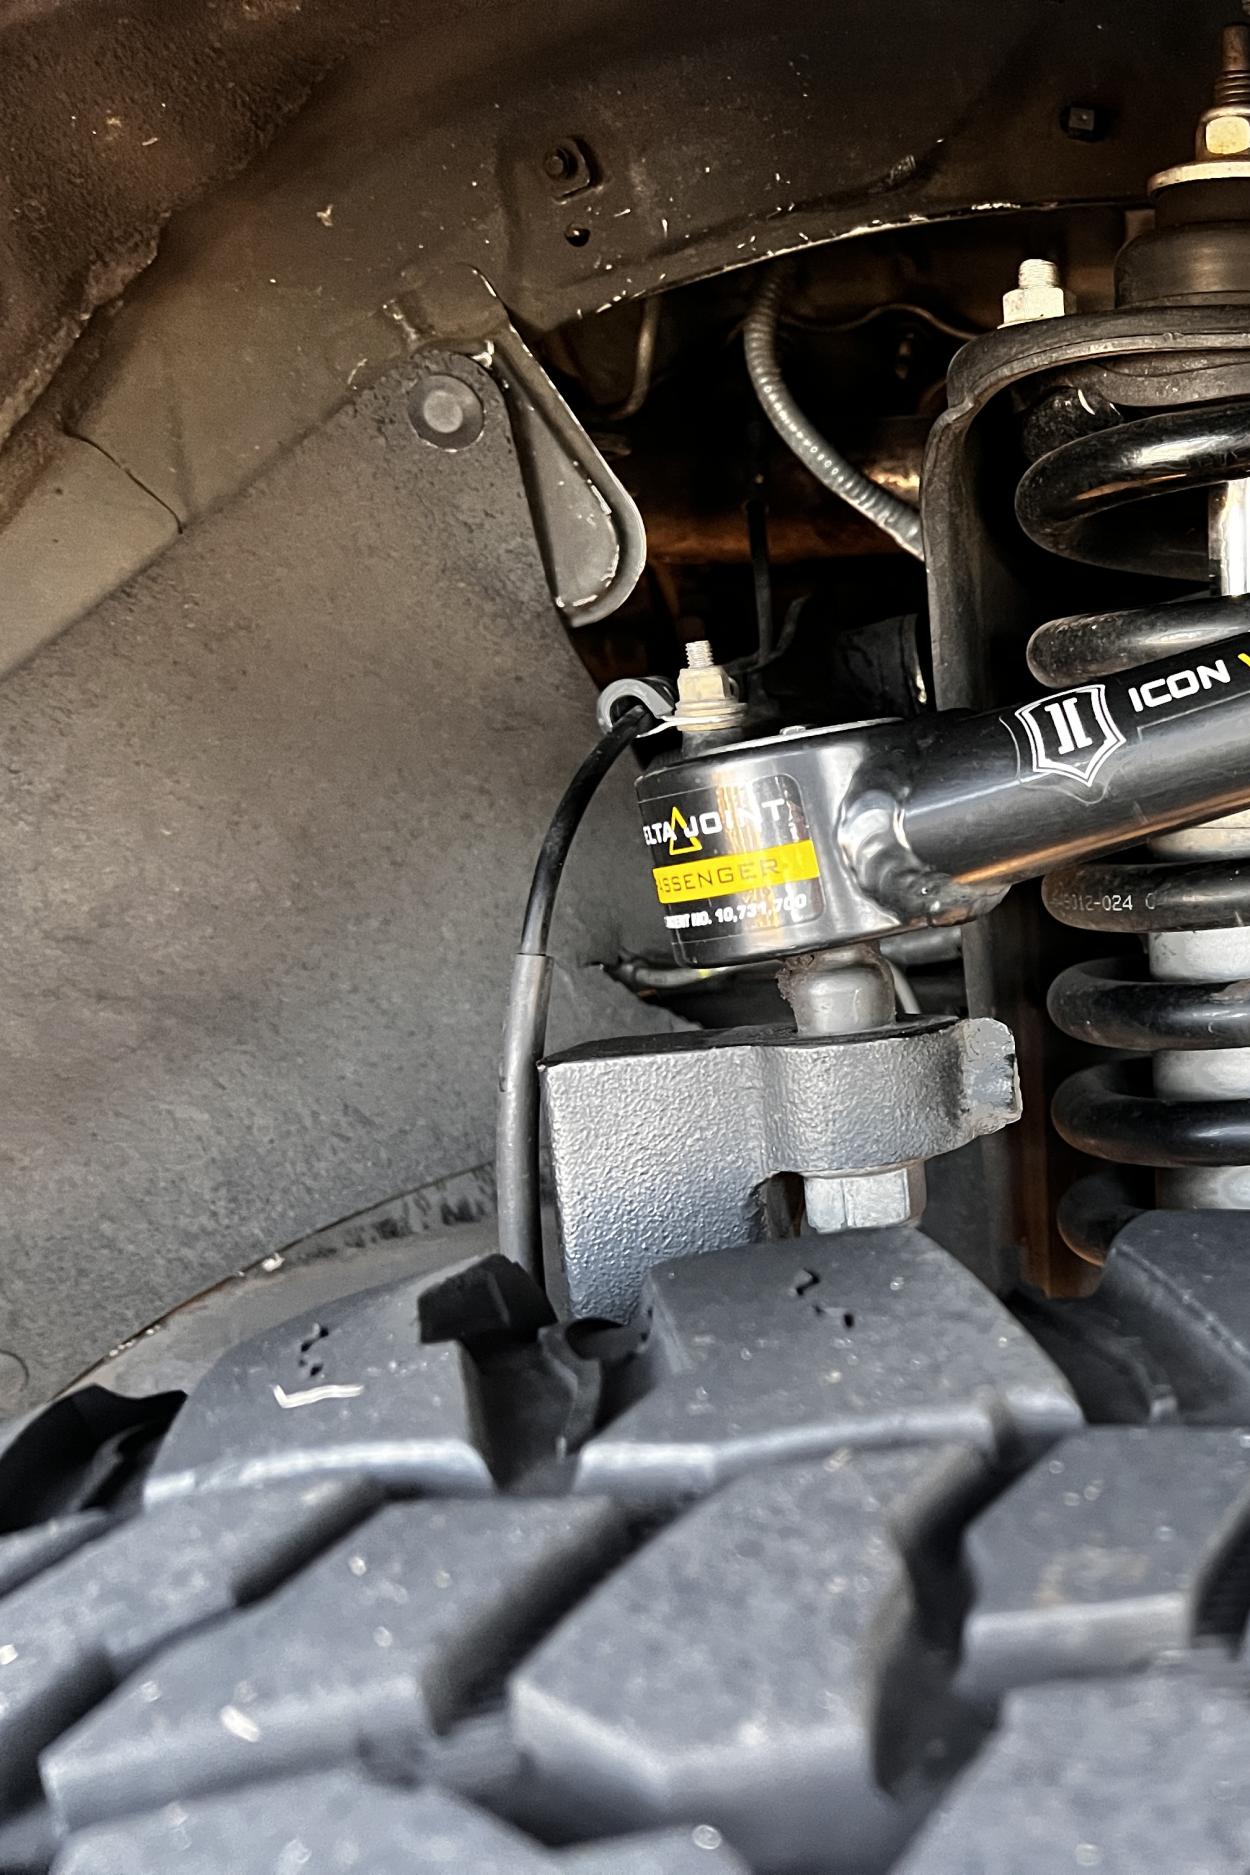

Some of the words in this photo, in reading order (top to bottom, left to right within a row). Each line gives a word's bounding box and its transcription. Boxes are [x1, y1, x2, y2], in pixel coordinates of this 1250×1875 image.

[1128, 660, 1230, 712] ICON
[642, 821, 678, 846] ELTA
[657, 858, 782, 894] SSENGER
